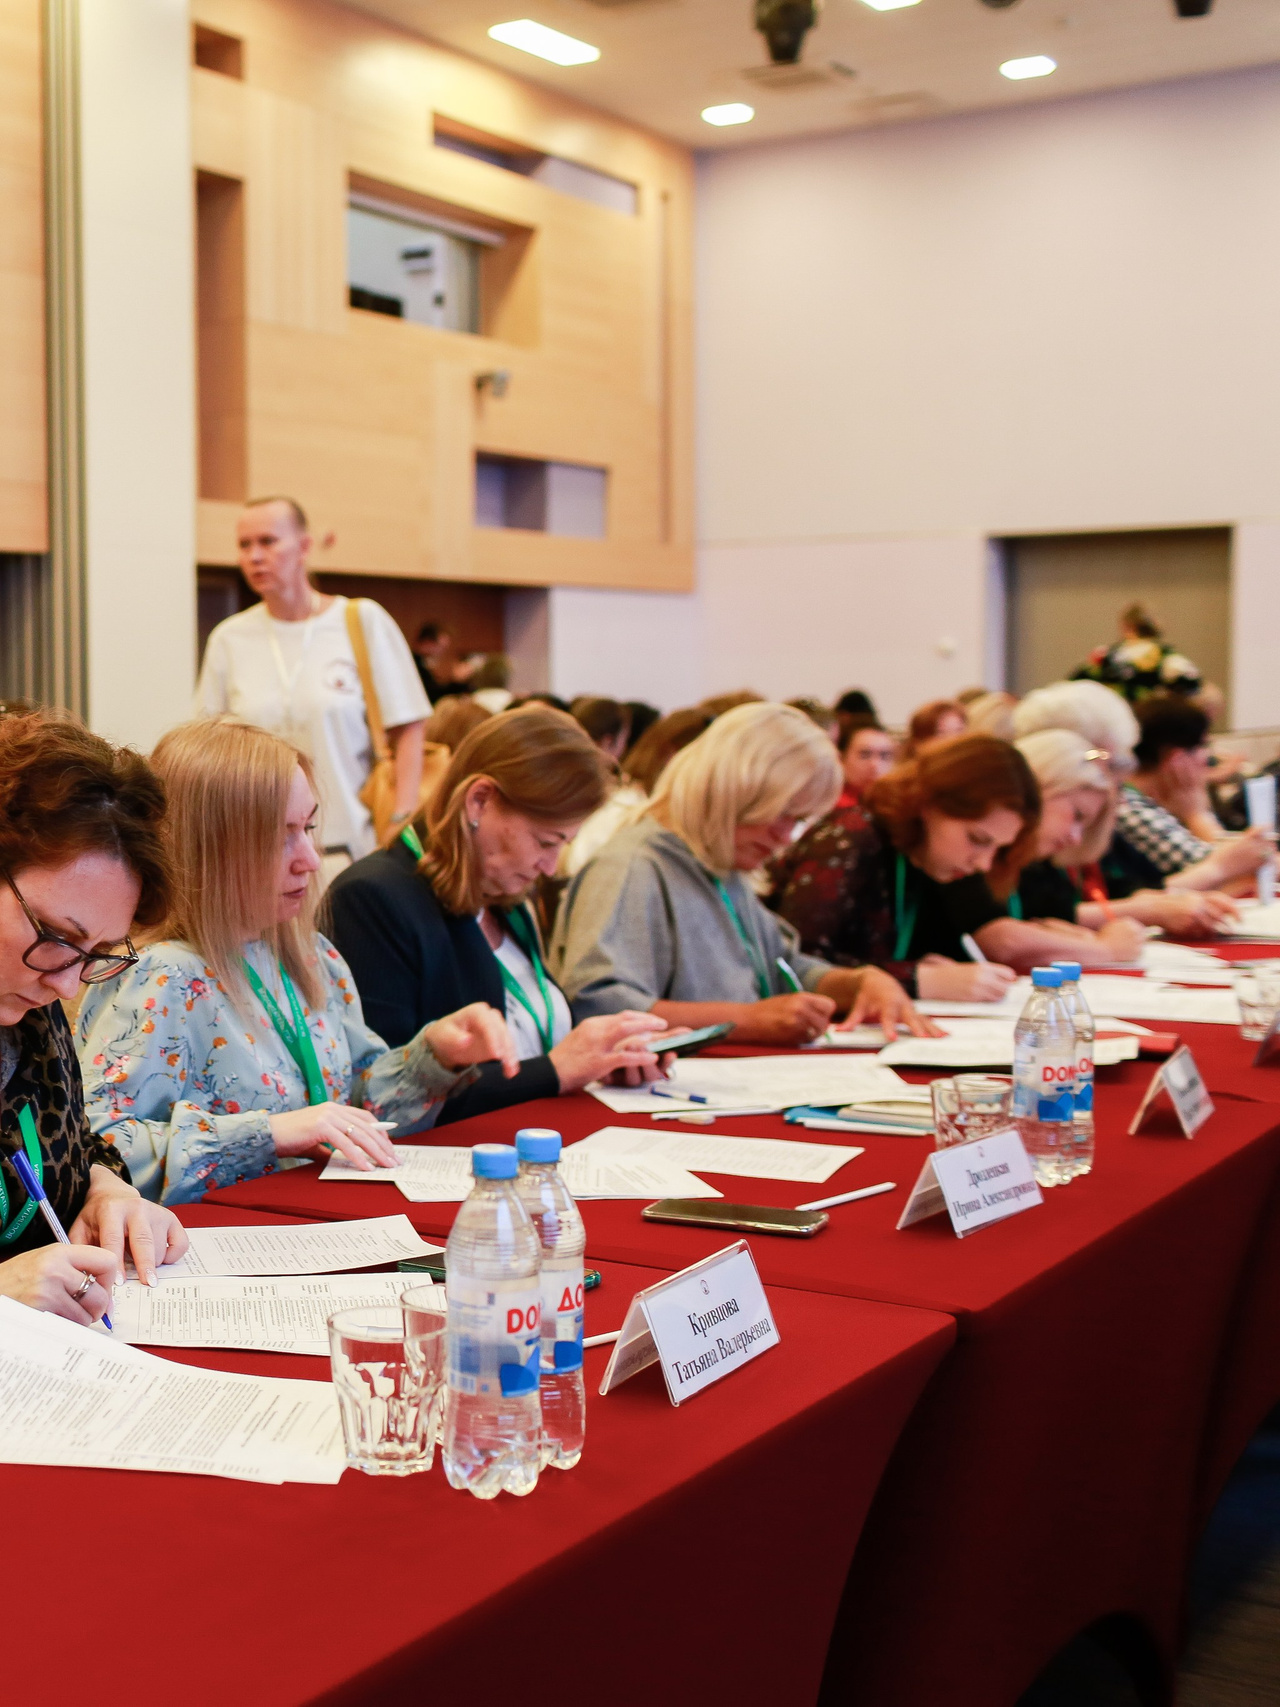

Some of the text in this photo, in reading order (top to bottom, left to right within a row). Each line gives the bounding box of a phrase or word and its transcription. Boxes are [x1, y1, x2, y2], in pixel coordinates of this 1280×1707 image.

[952, 1198, 982, 1220] Ирина
[506, 1302, 540, 1334] DO
[687, 1298, 740, 1338] Кривцова
[671, 1348, 719, 1384] Татьяна
[715, 1317, 772, 1360] Валерьевна
